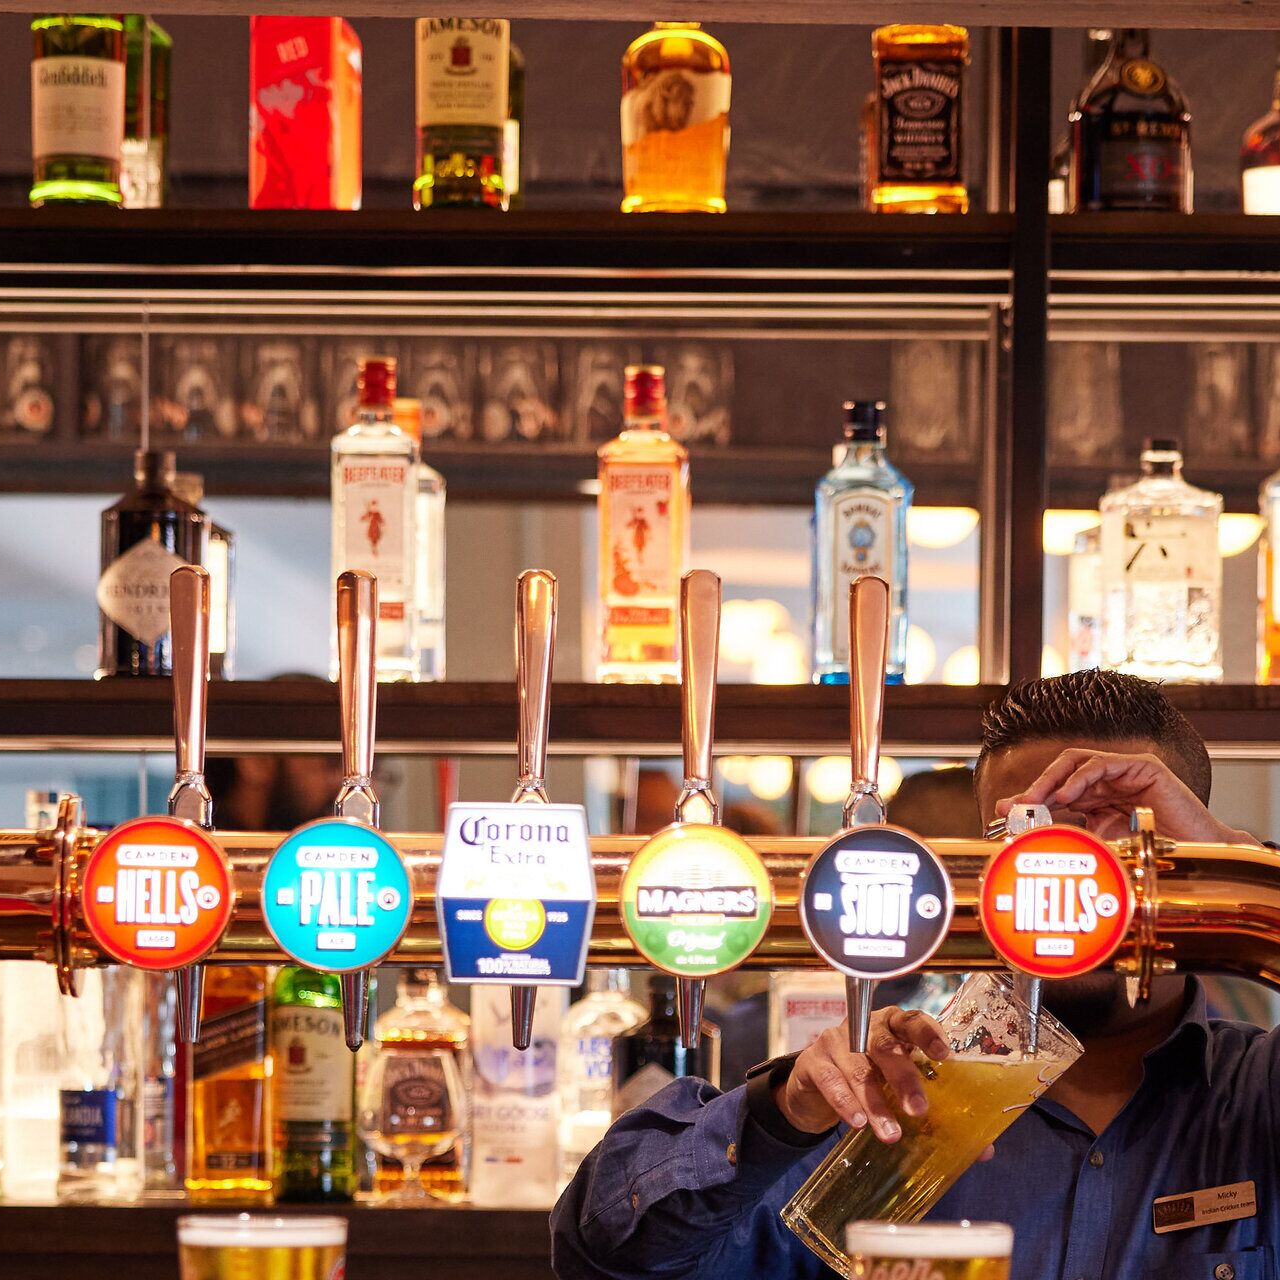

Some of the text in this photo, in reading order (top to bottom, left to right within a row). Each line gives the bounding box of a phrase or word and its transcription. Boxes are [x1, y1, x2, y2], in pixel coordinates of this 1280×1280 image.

[1124, 152, 1173, 181] XO
[343, 466, 404, 484] BEEFEATER
[609, 474, 669, 491] BEEFEATER
[459, 815, 570, 847] Corona
[124, 851, 191, 862] CAMDEN
[303, 852, 372, 863] CAMDEN
[489, 845, 546, 866] Extra
[843, 856, 911, 869] CAMDEN
[1023, 858, 1089, 870] CAMDEN
[115, 868, 200, 926] HELLS
[299, 870, 376, 927] PALE
[637, 888, 757, 913] MAGNERS
[1015, 877, 1099, 933] HELLS
[839, 883, 913, 937] STOUT
[1217, 1190, 1239, 1200] Micky
[1201, 1200, 1255, 1215] Indian Cricket team
